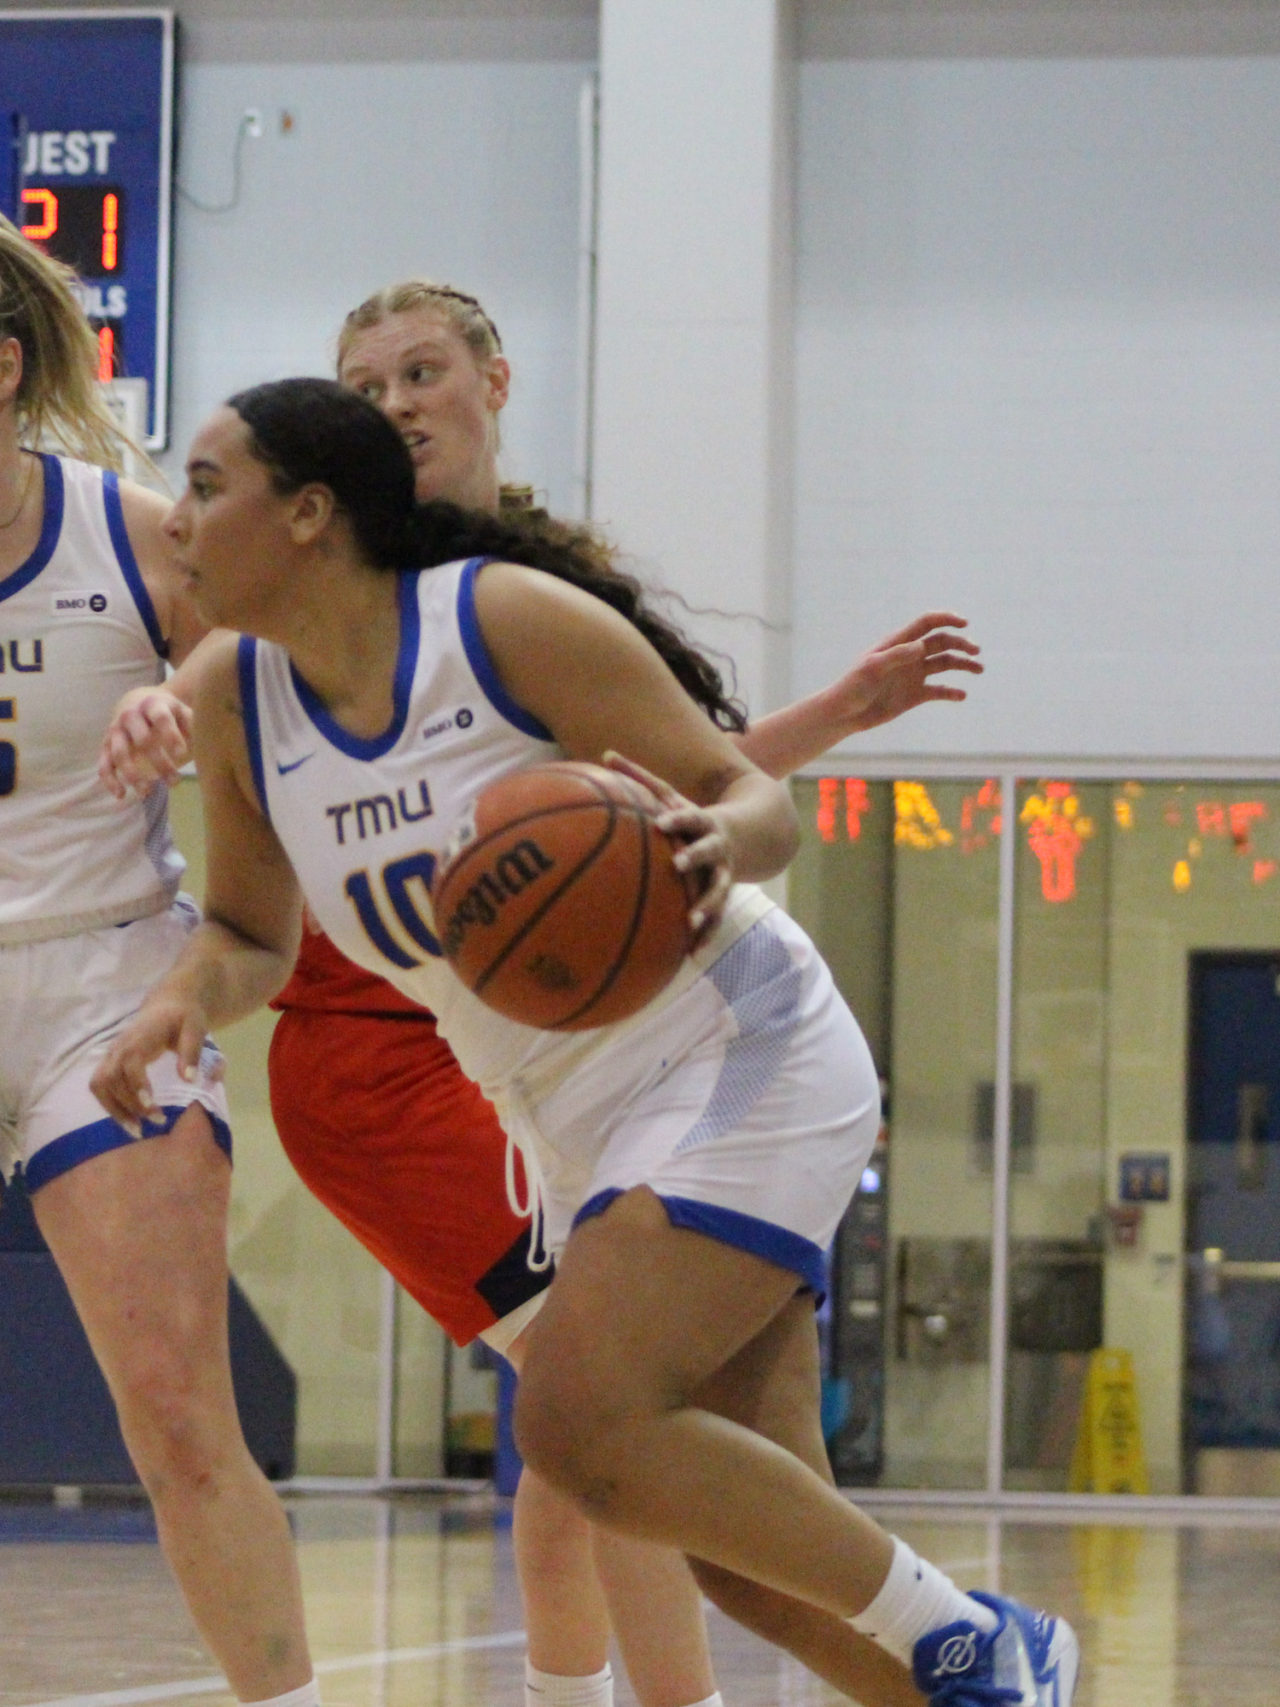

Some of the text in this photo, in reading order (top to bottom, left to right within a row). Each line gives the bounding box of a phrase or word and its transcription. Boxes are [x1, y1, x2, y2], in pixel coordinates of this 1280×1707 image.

[56, 599, 86, 610] BMO
[325, 779, 434, 845] TMU
[344, 851, 444, 970] 10
